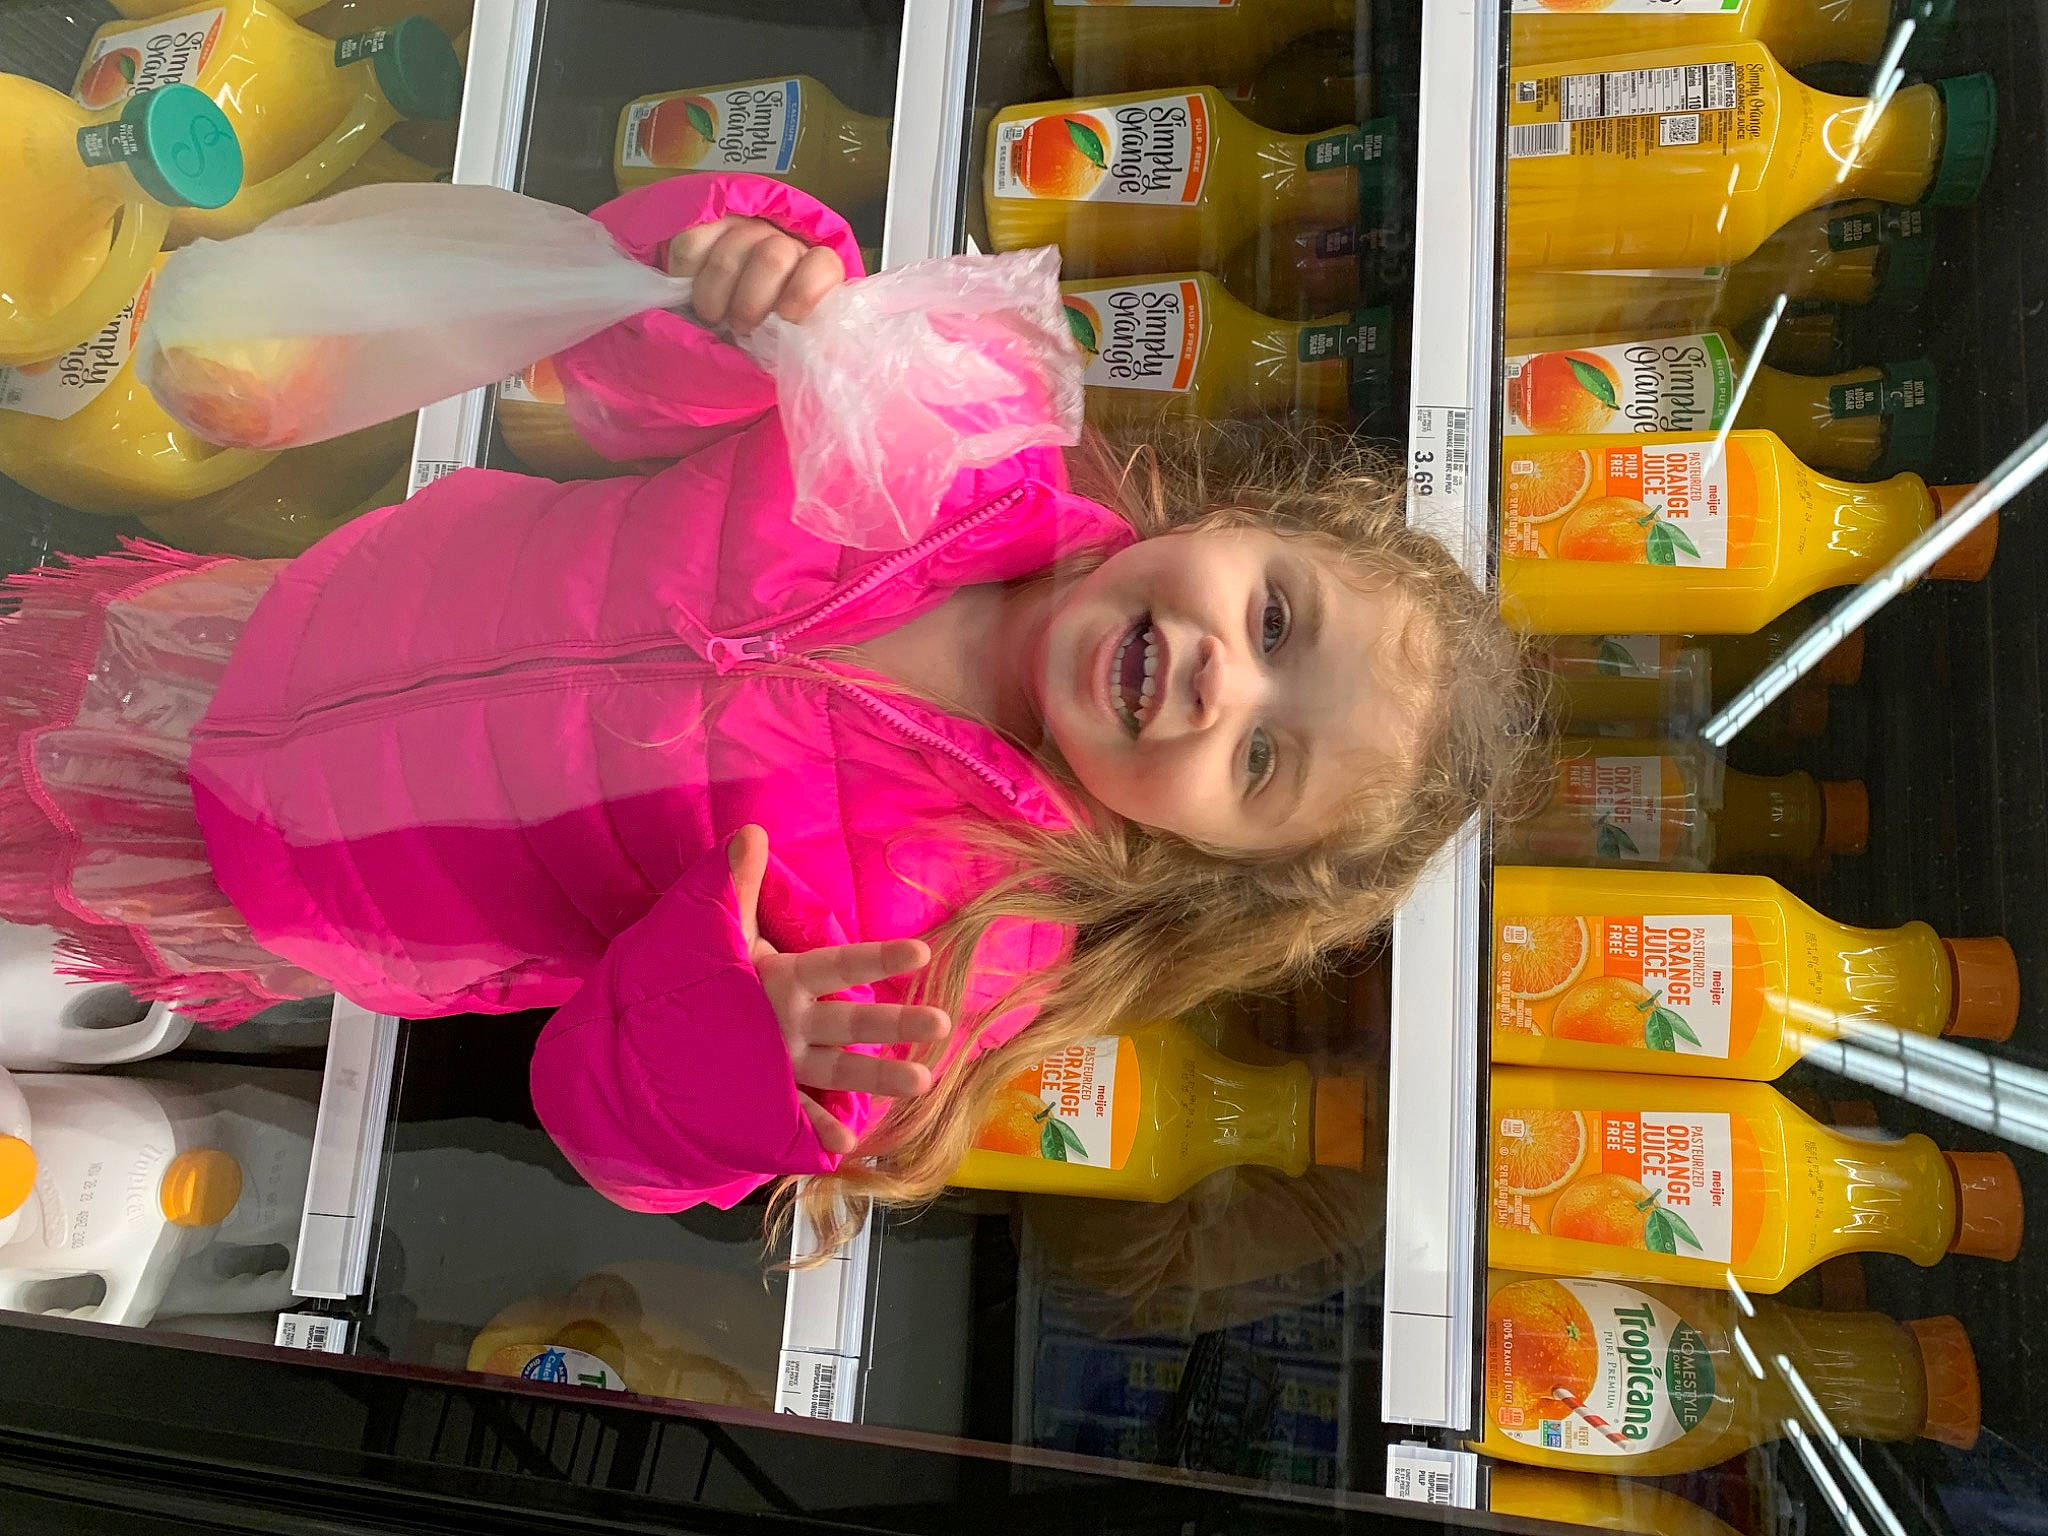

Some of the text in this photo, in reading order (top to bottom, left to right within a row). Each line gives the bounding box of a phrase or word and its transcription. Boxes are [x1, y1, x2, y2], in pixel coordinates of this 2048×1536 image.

[127, 35, 173, 97] Orang
[158, 32, 204, 85] Simp
[1724, 63, 1735, 88] Nutrition
[1687, 66, 1702, 110] Calories 110
[1725, 89, 1735, 108] Facts
[1736, 65, 1745, 140] 100% ORANGE JUICE
[1745, 63, 1765, 138] Simply Orange
[111, 136, 120, 144] C
[120, 124, 130, 155] VITAMIN
[126, 124, 137, 152] RICH IN
[718, 91, 752, 163] Orange
[741, 90, 783, 164] Simply
[787, 102, 797, 141] CALCIUM
[1111, 107, 1148, 194] Orange
[1141, 107, 1186, 195] Simply
[1193, 146, 1202, 173] FREE
[1316, 143, 1325, 163] SUGAR
[1325, 143, 1333, 163] ADDED
[77, 298, 135, 389] mply
[1103, 292, 1141, 378] Orange
[1132, 292, 1179, 380] Simply
[1184, 332, 1193, 360] FREE
[1309, 335, 1318, 355] SUGAR
[58, 341, 89, 386] nge
[1624, 346, 1662, 433] Orange
[1660, 346, 1706, 431] Simply
[1715, 359, 1727, 416] HIGH PULP
[1845, 389, 1855, 410] SUGAR
[1854, 388, 1864, 409] ADDED
[1863, 392, 1874, 402] NO
[1902, 380, 1914, 408] VITAMIN
[1414, 451, 1434, 496] 3.69
[1610, 453, 1624, 478] FREE
[1623, 453, 1638, 479] PULP
[1643, 453, 1666, 496] JUICE
[1666, 452, 1689, 519] ORANGE
[1688, 452, 1701, 502] PASTEURIZED
[1706, 484, 1721, 515] meijer
[1569, 765, 1580, 787] FREE
[1581, 765, 1592, 789] PULP
[1597, 765, 1613, 804] JUICE
[1613, 766, 1632, 824] ORANGE
[1608, 924, 1622, 955] FREE
[1623, 924, 1638, 958] PULP
[1644, 926, 1667, 978] JUICE
[1692, 928, 1705, 988] PASTEURIZED
[1667, 927, 1691, 1006] ORANGE
[1710, 970, 1724, 1005] meijer
[1042, 1052, 1064, 1091] UICE
[1060, 1046, 1084, 1117] ORANGE
[1081, 1046, 1096, 1100] PASTEURIZED
[1095, 1085, 1107, 1116] meijer
[1606, 1120, 1621, 1150] FREE
[1622, 1121, 1636, 1154] PULP
[1643, 1122, 1665, 1176] JUICE
[1691, 1126, 1705, 1187] PASTEURIZED
[1667, 1125, 1690, 1206] ORANGE
[1710, 1171, 1723, 1205] meijer
[812, 1363, 821, 1392] TROPICANA
[1503, 1318, 1513, 1404] 100% ORANGE JUICE
[1603, 1331, 1617, 1409] PURE PREMIUM
[1613, 1303, 1662, 1440] Tropicana
[1672, 1350, 1682, 1401] SOME PULP
[1679, 1330, 1698, 1423] HOMESTYLE
[1579, 1426, 1588, 1446] NEVER
